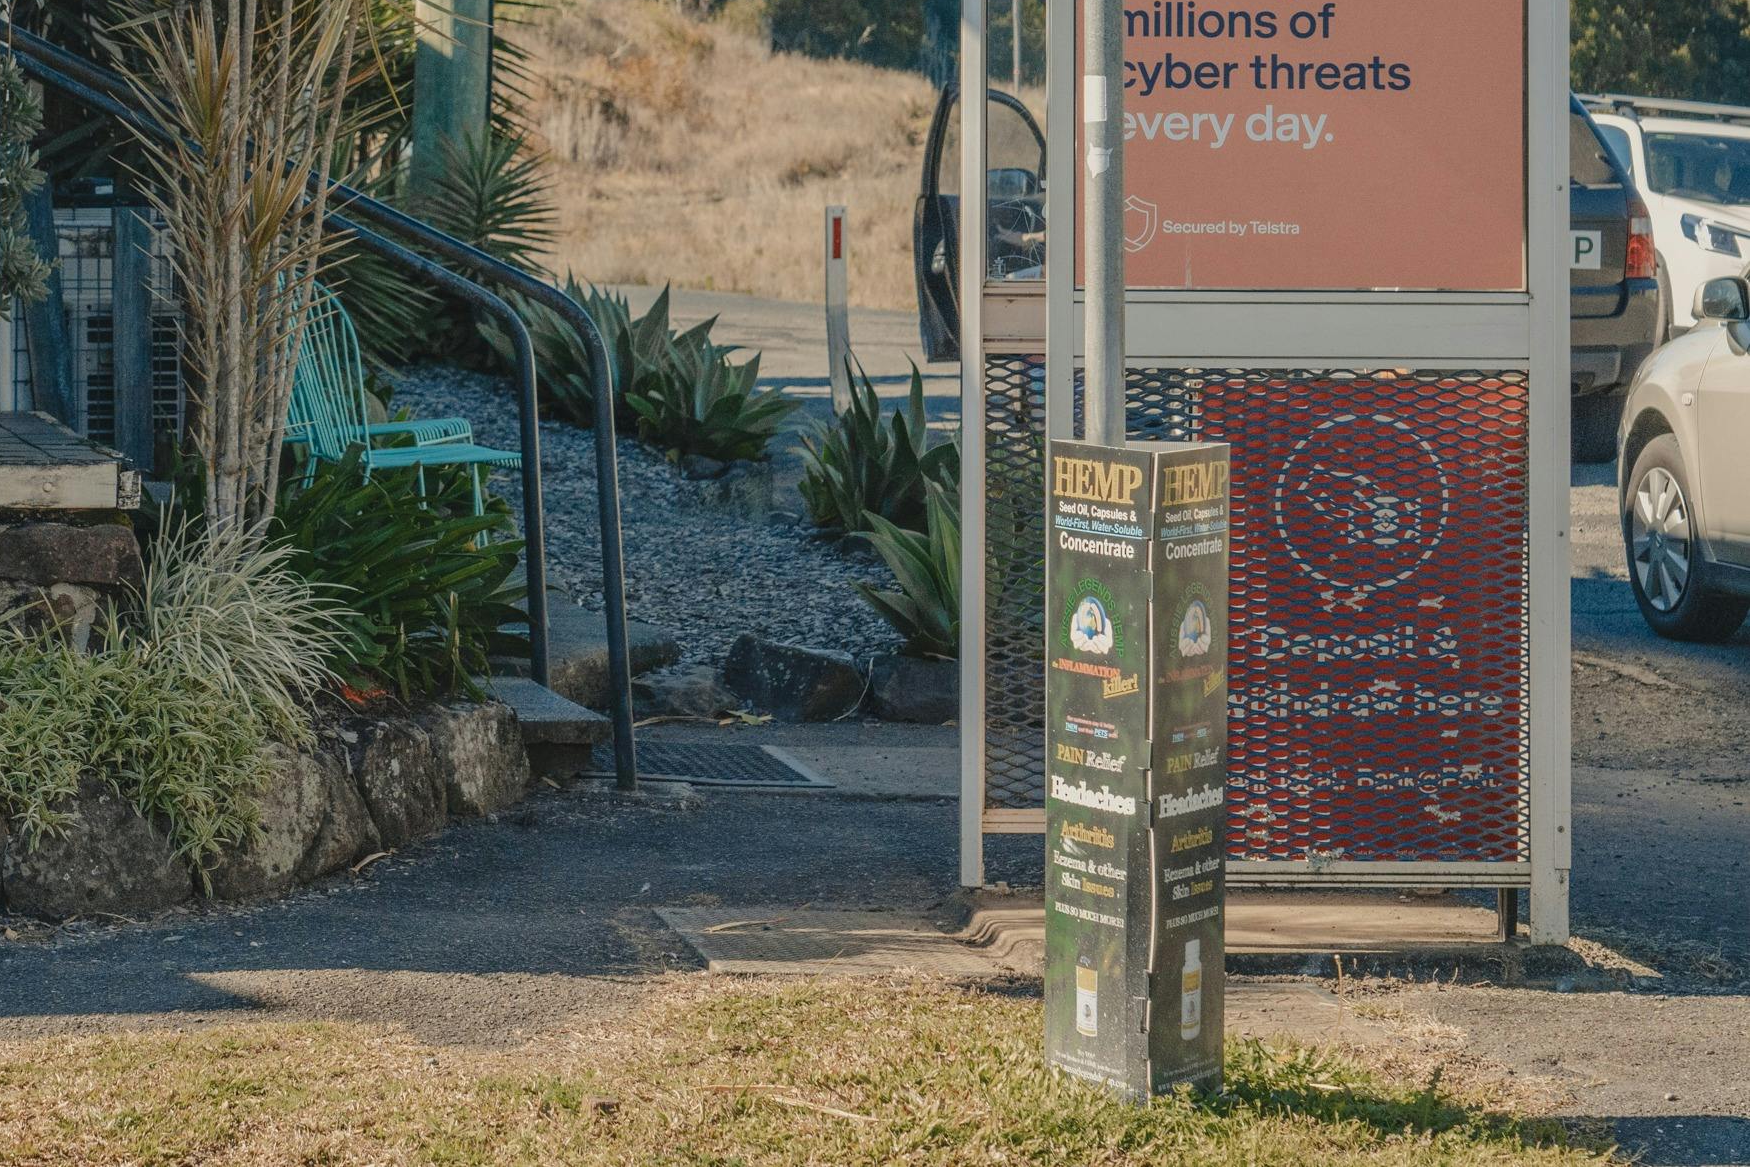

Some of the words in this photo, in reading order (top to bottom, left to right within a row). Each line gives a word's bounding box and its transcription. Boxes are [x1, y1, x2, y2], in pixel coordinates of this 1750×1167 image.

[1123, 1, 1278, 38] millions
[1289, 3, 1336, 38] of
[1250, 54, 1411, 90] threats
[1245, 105, 1334, 149] day.
[1162, 220, 1226, 233] Secured
[1229, 220, 1247, 236] by
[1250, 221, 1300, 234] Telstra
[1575, 236, 1594, 264] P
[1053, 456, 1143, 505] HEMP
[1161, 460, 1229, 506] HEMP
[1055, 515, 1090, 531] World-First,
[1091, 520, 1143, 536] Water-Soluble
[1059, 501, 1076, 514] Seed
[1077, 503, 1090, 518] Oil,
[1091, 505, 1128, 520] Capsules
[1130, 510, 1137, 522] &
[1165, 511, 1181, 523] Seed
[1194, 506, 1218, 521] Capsules
[1060, 531, 1135, 559] Concentrate
[1166, 536, 1223, 560] Concentrate
[1060, 594, 1076, 649] AUSSIE
[1073, 577, 1116, 611] LEGENDS
[1112, 615, 1125, 659] HEMP
[1058, 657, 1121, 679] INFLAMMATION
[1103, 673, 1138, 697] killer!
[1056, 743, 1084, 765] PAIN
[1086, 750, 1126, 772] Relief
[1167, 753, 1193, 774] PAIN
[1193, 746, 1219, 769] Relief
[1051, 775, 1136, 815] Headaches
[1159, 783, 1223, 818] Headaches
[1061, 820, 1115, 849] Arthritis
[1170, 826, 1212, 853] Arthritis
[1053, 850, 1087, 873] Eczema
[1087, 860, 1097, 874] &
[1097, 863, 1127, 881] other
[1163, 864, 1194, 883] Eczema
[1195, 862, 1201, 875] &
[1202, 856, 1220, 872] other
[1061, 872, 1081, 890] Skin
[1081, 877, 1114, 898] Issues
[1172, 885, 1190, 900] Skin
[1191, 879, 1213, 895] Issues
[1055, 901, 1070, 914] PLUS
[1070, 906, 1079, 917] SO
[1079, 908, 1100, 922] MUCH
[1166, 918, 1180, 930] PLUS
[1180, 915, 1187, 925] SO
[1187, 911, 1201, 923] MUCH
